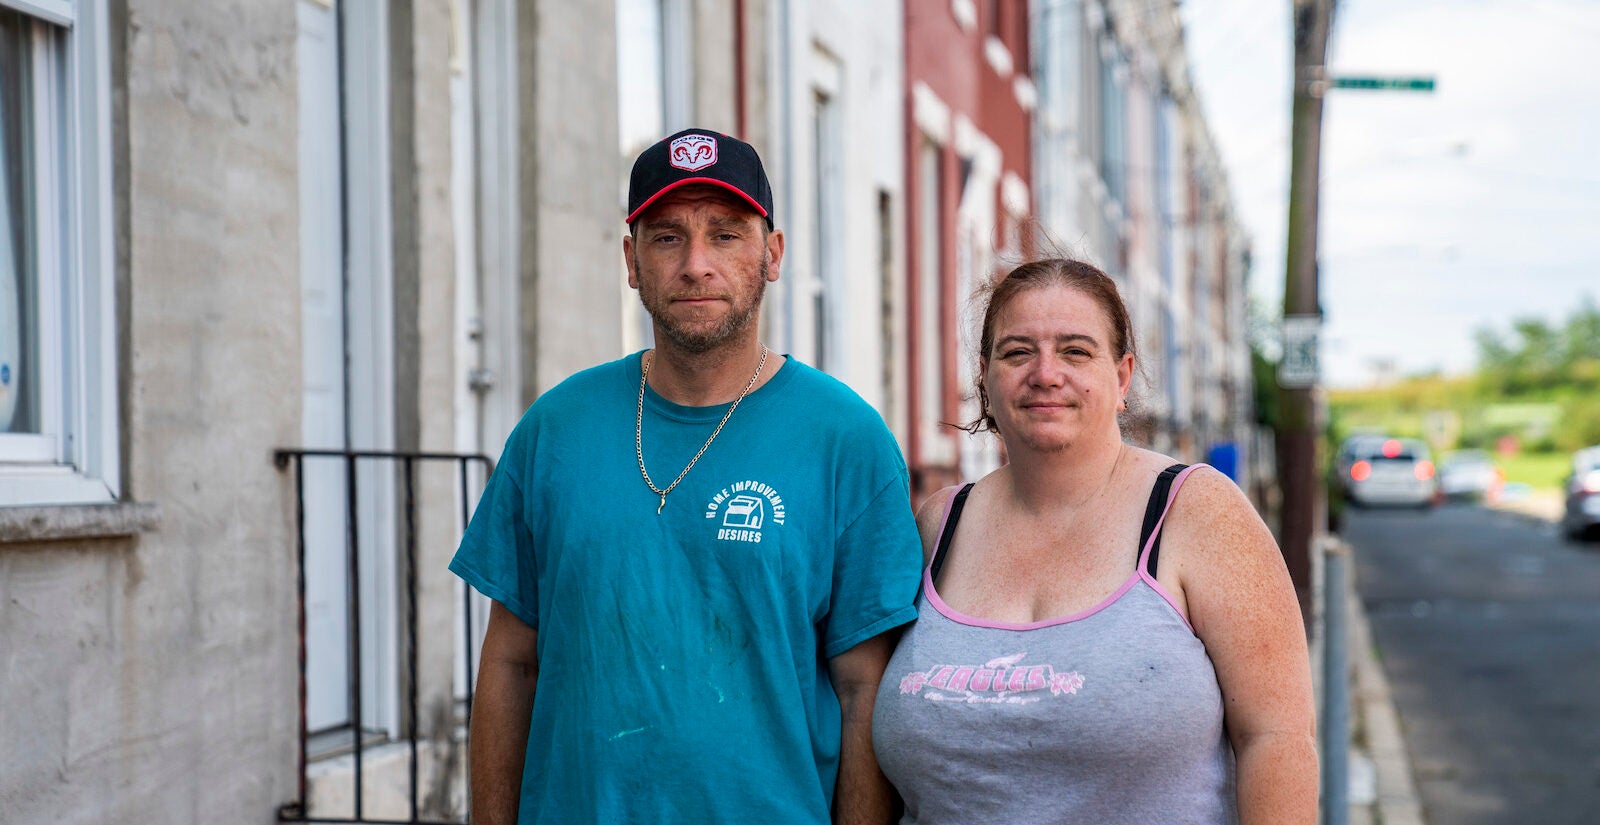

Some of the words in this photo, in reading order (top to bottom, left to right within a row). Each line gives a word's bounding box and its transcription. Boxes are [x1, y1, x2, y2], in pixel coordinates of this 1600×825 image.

[672, 136, 714, 145] DODGE
[705, 488, 730, 519] HOME
[731, 480, 786, 526] IMPROVEMENT
[717, 528, 762, 543] DESIRES
[927, 667, 1047, 692] EAGLES
